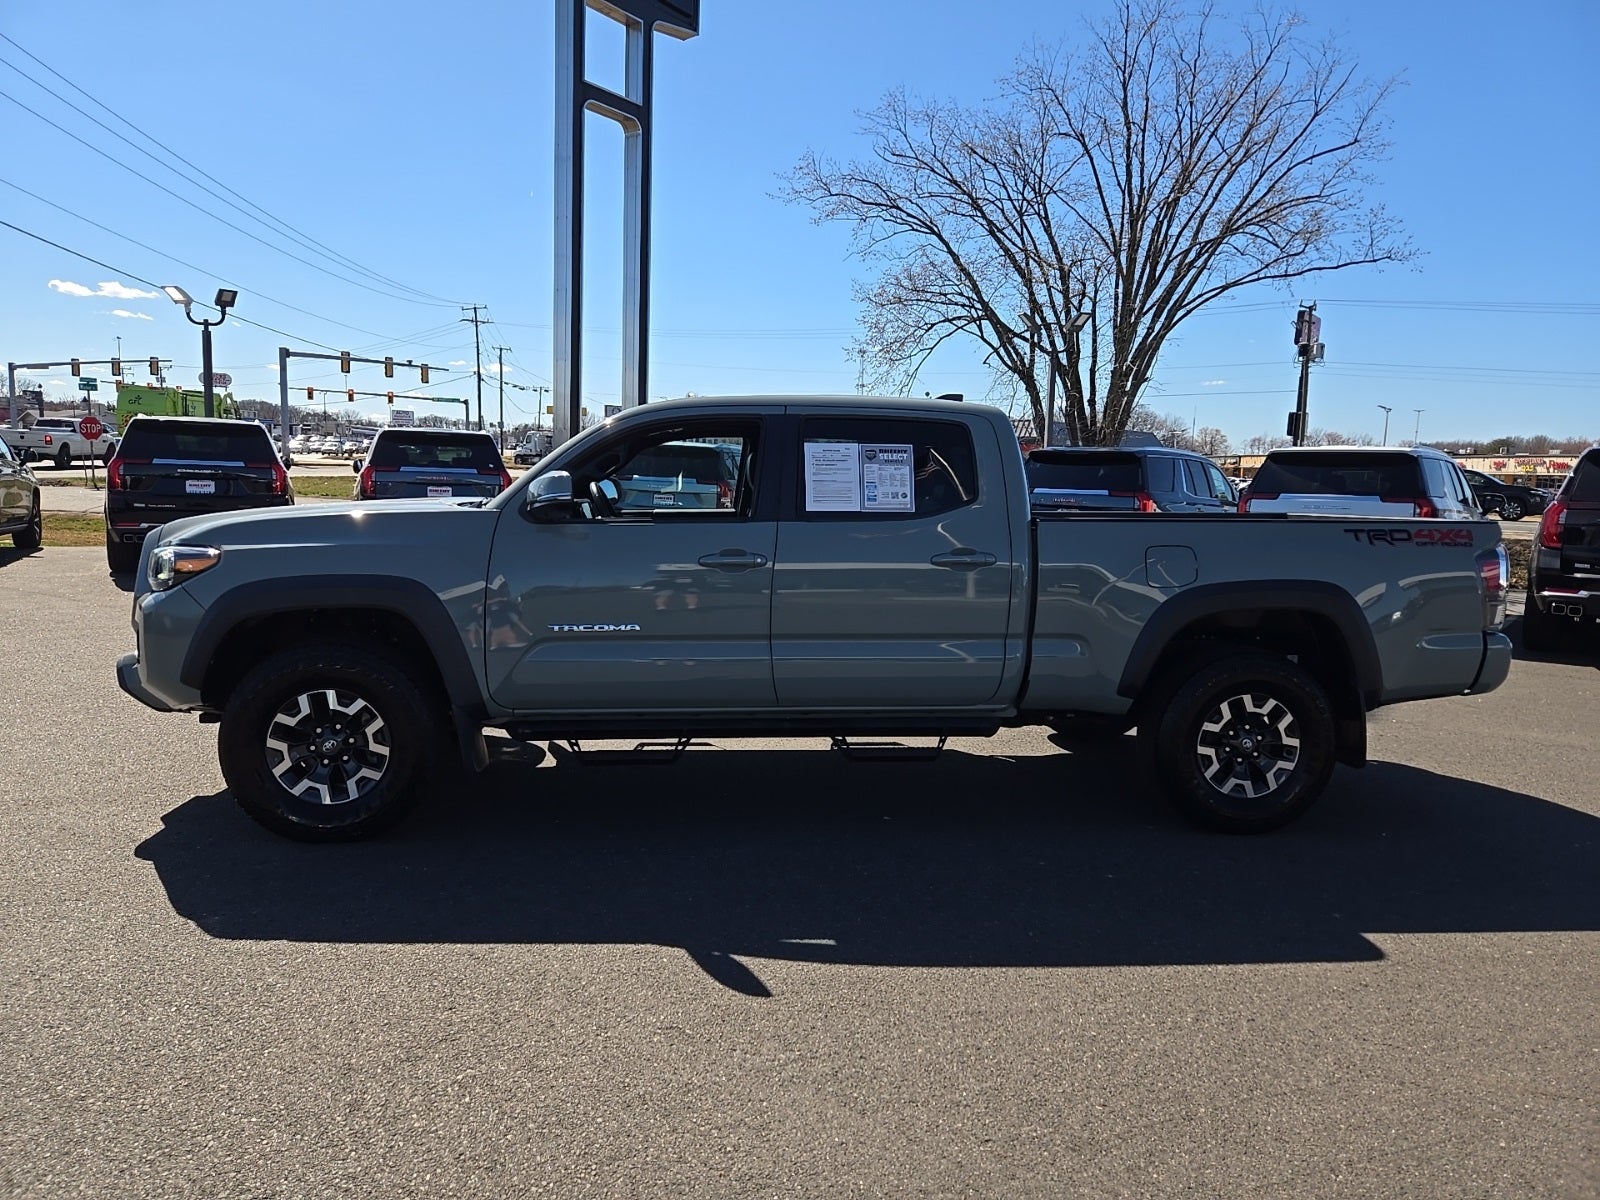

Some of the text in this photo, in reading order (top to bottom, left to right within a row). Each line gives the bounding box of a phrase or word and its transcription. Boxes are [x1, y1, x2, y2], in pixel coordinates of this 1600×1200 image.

[80, 423, 101, 434] STOP
[1344, 529, 1412, 547] TRD
[547, 624, 641, 632] TACOMA
